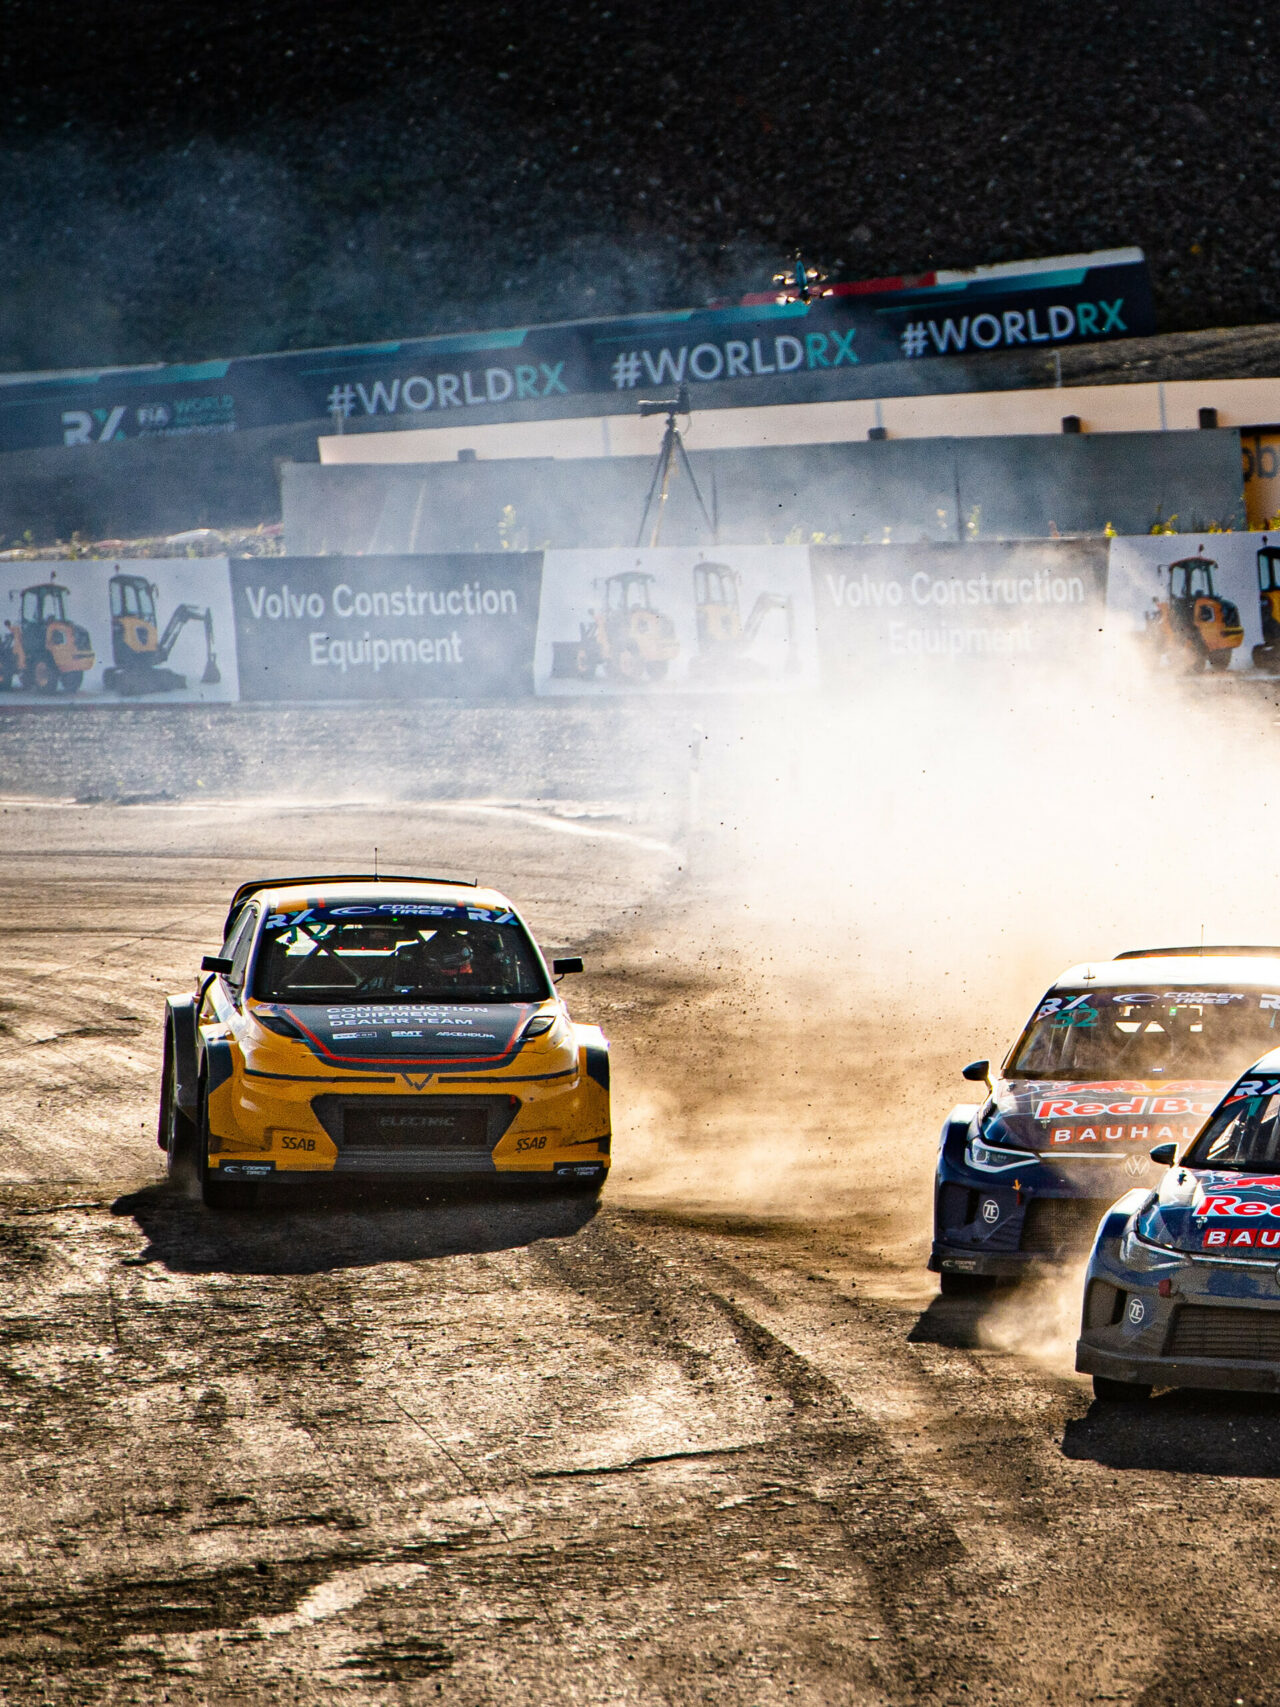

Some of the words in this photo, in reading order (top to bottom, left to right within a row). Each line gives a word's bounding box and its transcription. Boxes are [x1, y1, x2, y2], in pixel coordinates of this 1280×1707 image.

[902, 298, 1128, 358] #WORLDRX
[612, 327, 860, 389] #WORLDRX
[327, 361, 569, 418] #WORLDRX
[826, 573, 902, 607] Volvo
[911, 569, 1086, 606] Construction
[246, 584, 324, 620] Volvo
[332, 581, 518, 618] Construction
[310, 631, 464, 674] Equipment
[378, 904, 456, 912] COOPER
[1163, 992, 1245, 1000] COOPER
[1173, 997, 1230, 1005] TIRES
[326, 1005, 489, 1013] CONSTRUCTION
[327, 1012, 450, 1020] EQUIPMENT
[329, 1018, 410, 1027] DEALER
[1036, 1097, 1147, 1119] Red
[1150, 1097, 1215, 1117] Bu
[1054, 1126, 1197, 1143] BAUHAU
[281, 1136, 316, 1151] SSAB
[516, 1136, 548, 1151] SSAB
